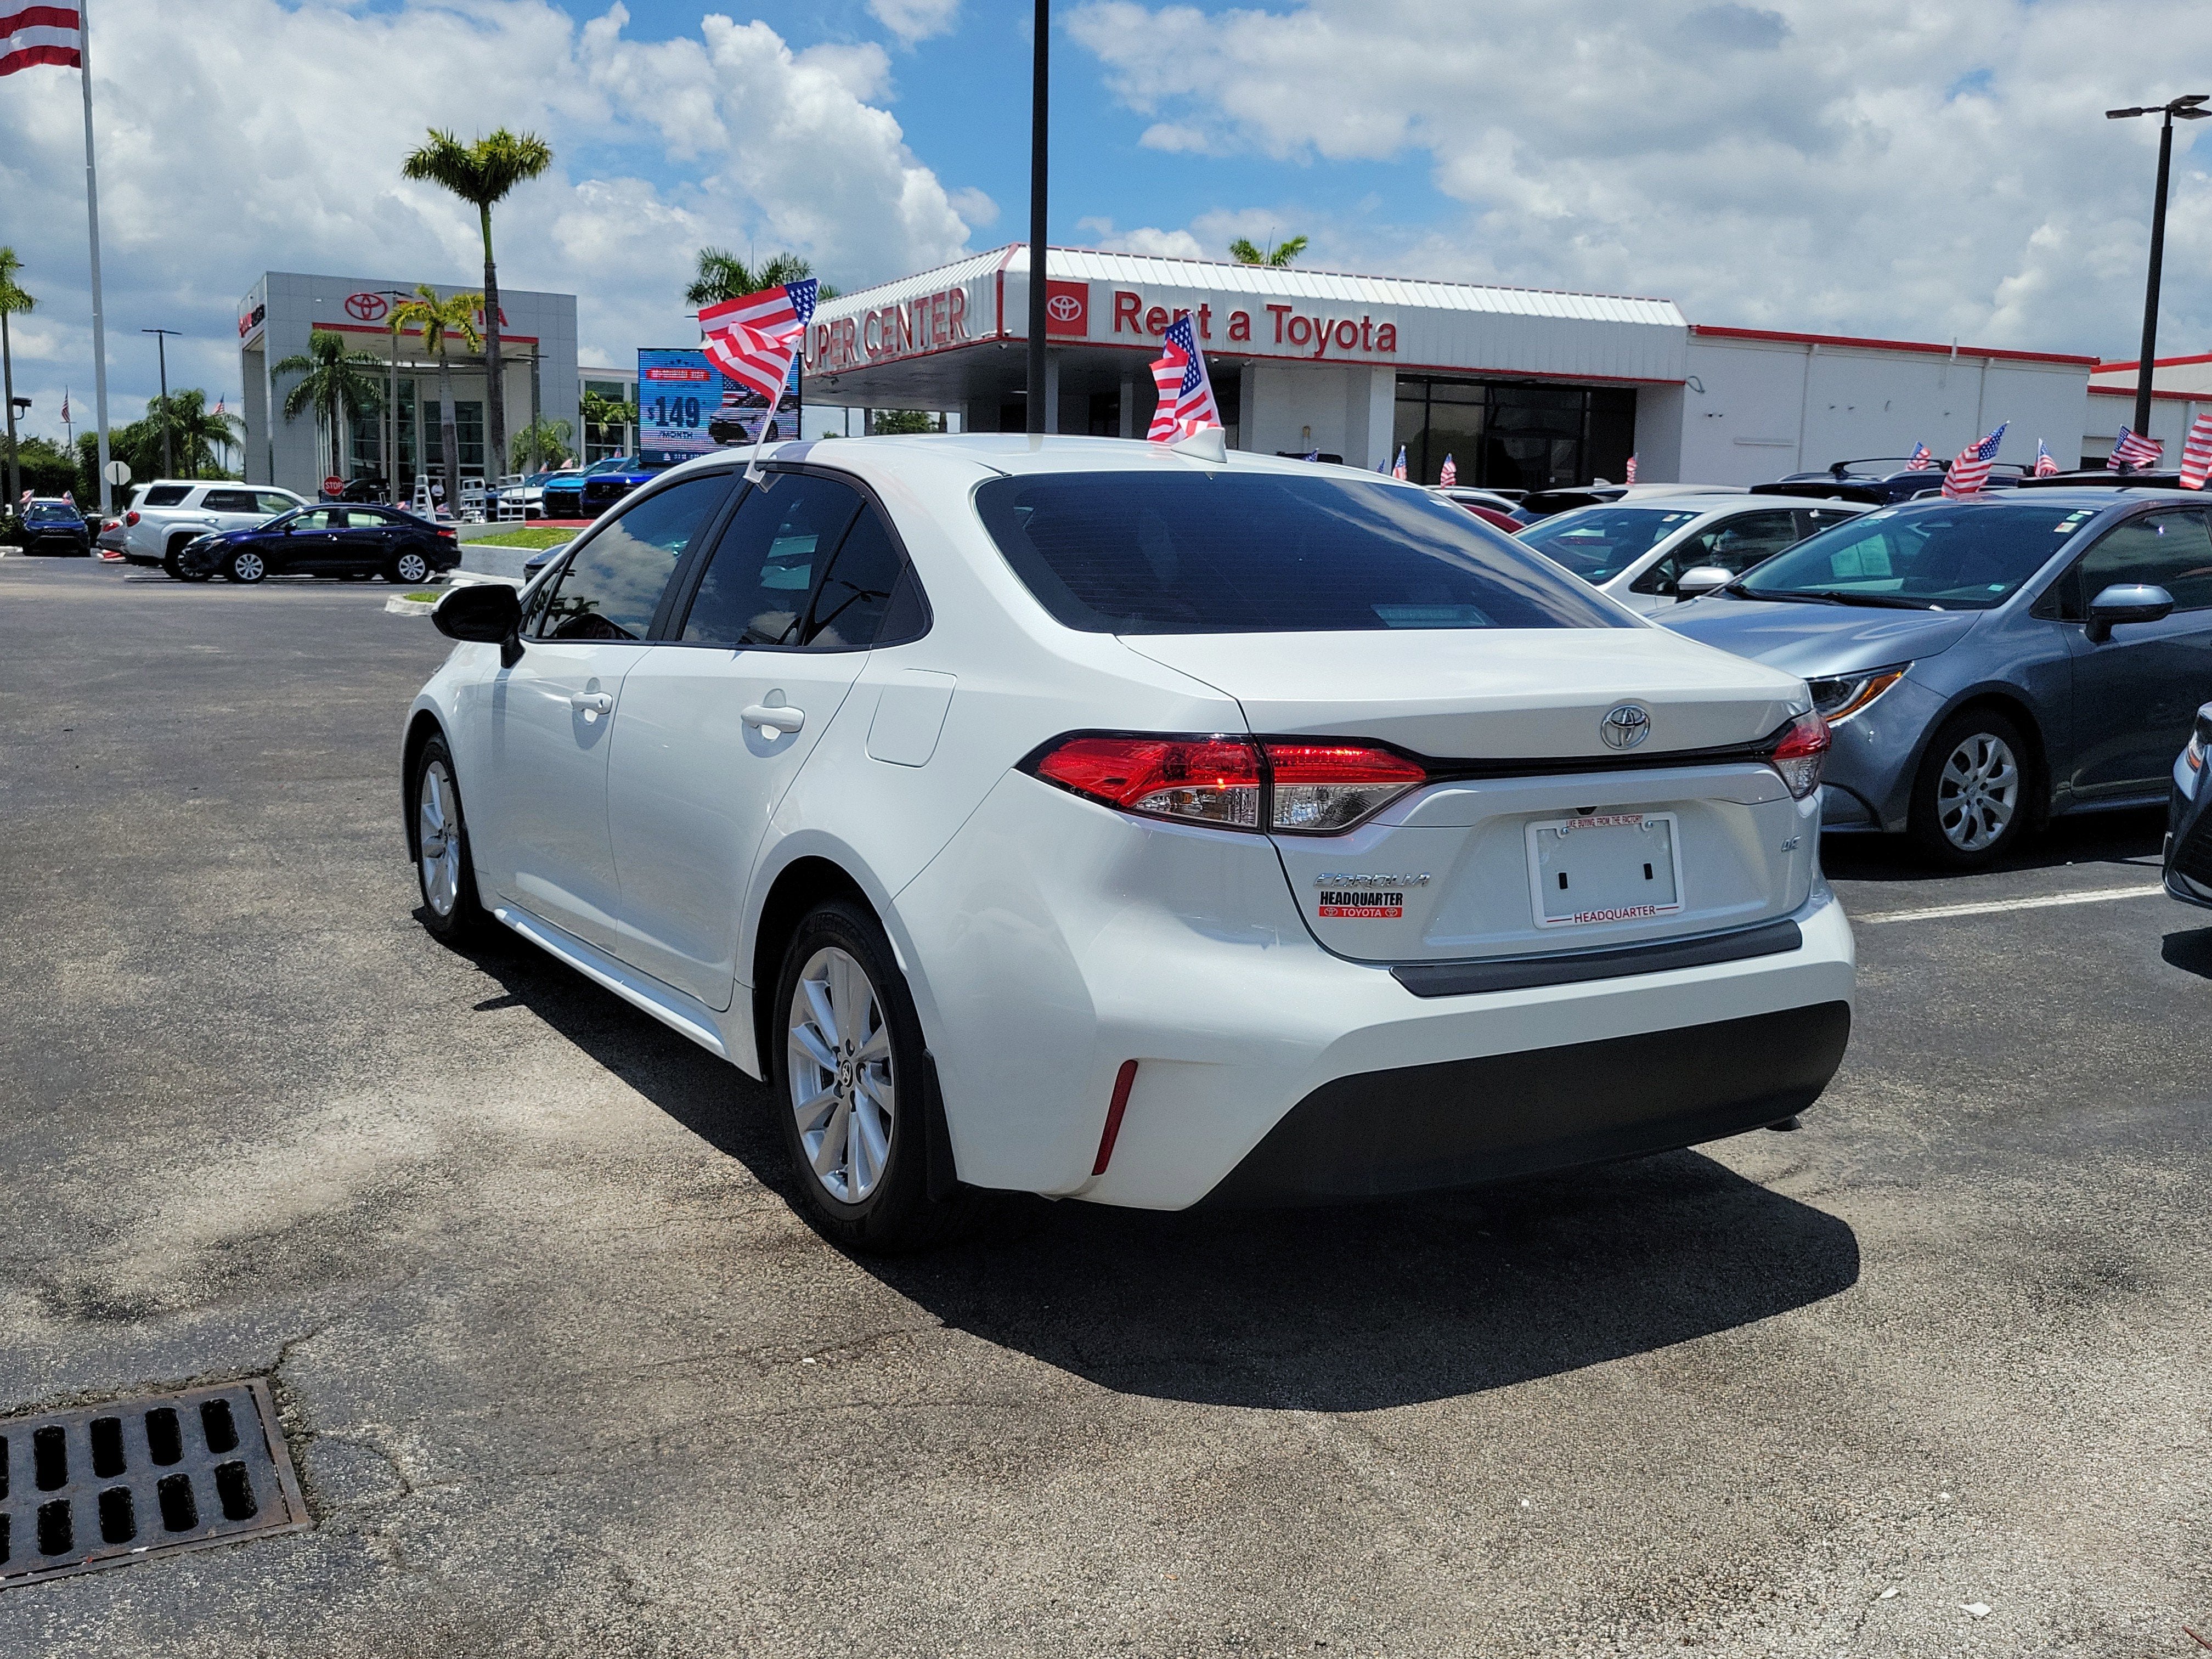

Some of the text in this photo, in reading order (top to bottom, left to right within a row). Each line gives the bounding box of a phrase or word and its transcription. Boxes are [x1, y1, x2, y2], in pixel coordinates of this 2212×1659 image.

[803, 287, 971, 371] UPER CENTER
[1227, 309, 1251, 342] a
[1266, 303, 1397, 358] Toyota
[1566, 820, 1576, 828] LIKE
[1578, 819, 1595, 827] BUYING
[1597, 817, 1610, 826] FROM
[1611, 816, 1620, 825] THE
[1314, 872, 1431, 889] COROLLA
[1320, 891, 1403, 906] HEADQUARTER
[1342, 908, 1381, 917] TOYOTA
[1574, 906, 1656, 923] HEADQUARTER
